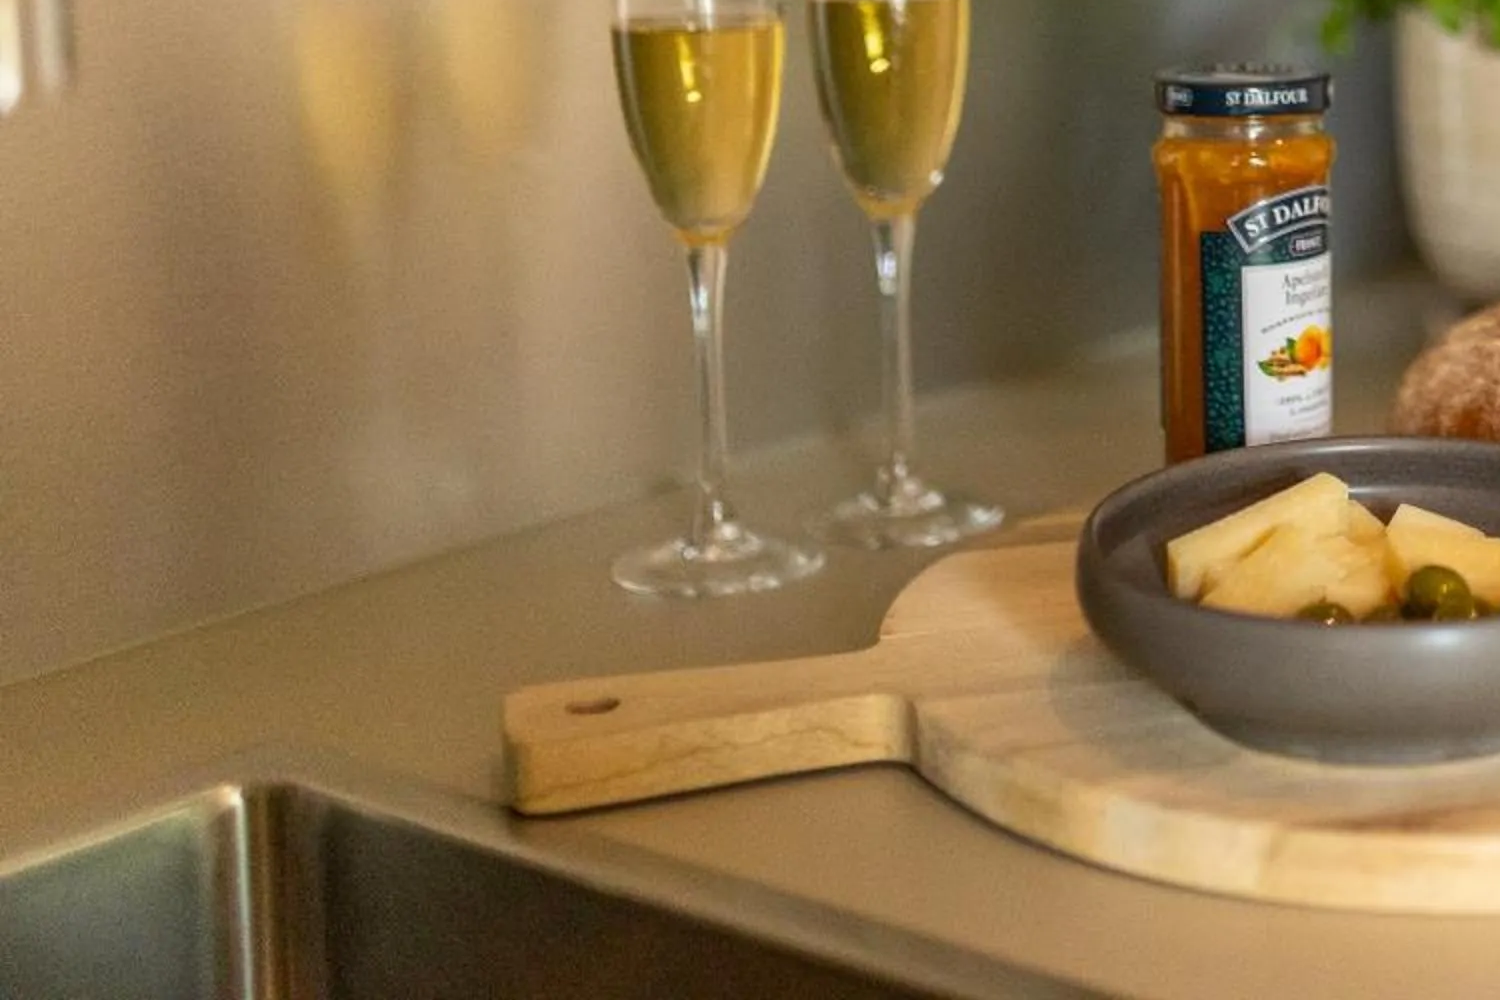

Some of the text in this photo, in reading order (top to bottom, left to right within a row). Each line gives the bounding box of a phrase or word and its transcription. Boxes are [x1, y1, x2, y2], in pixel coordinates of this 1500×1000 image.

[1225, 88, 1308, 106] ST DALFOUR
[1244, 213, 1269, 237] ST
